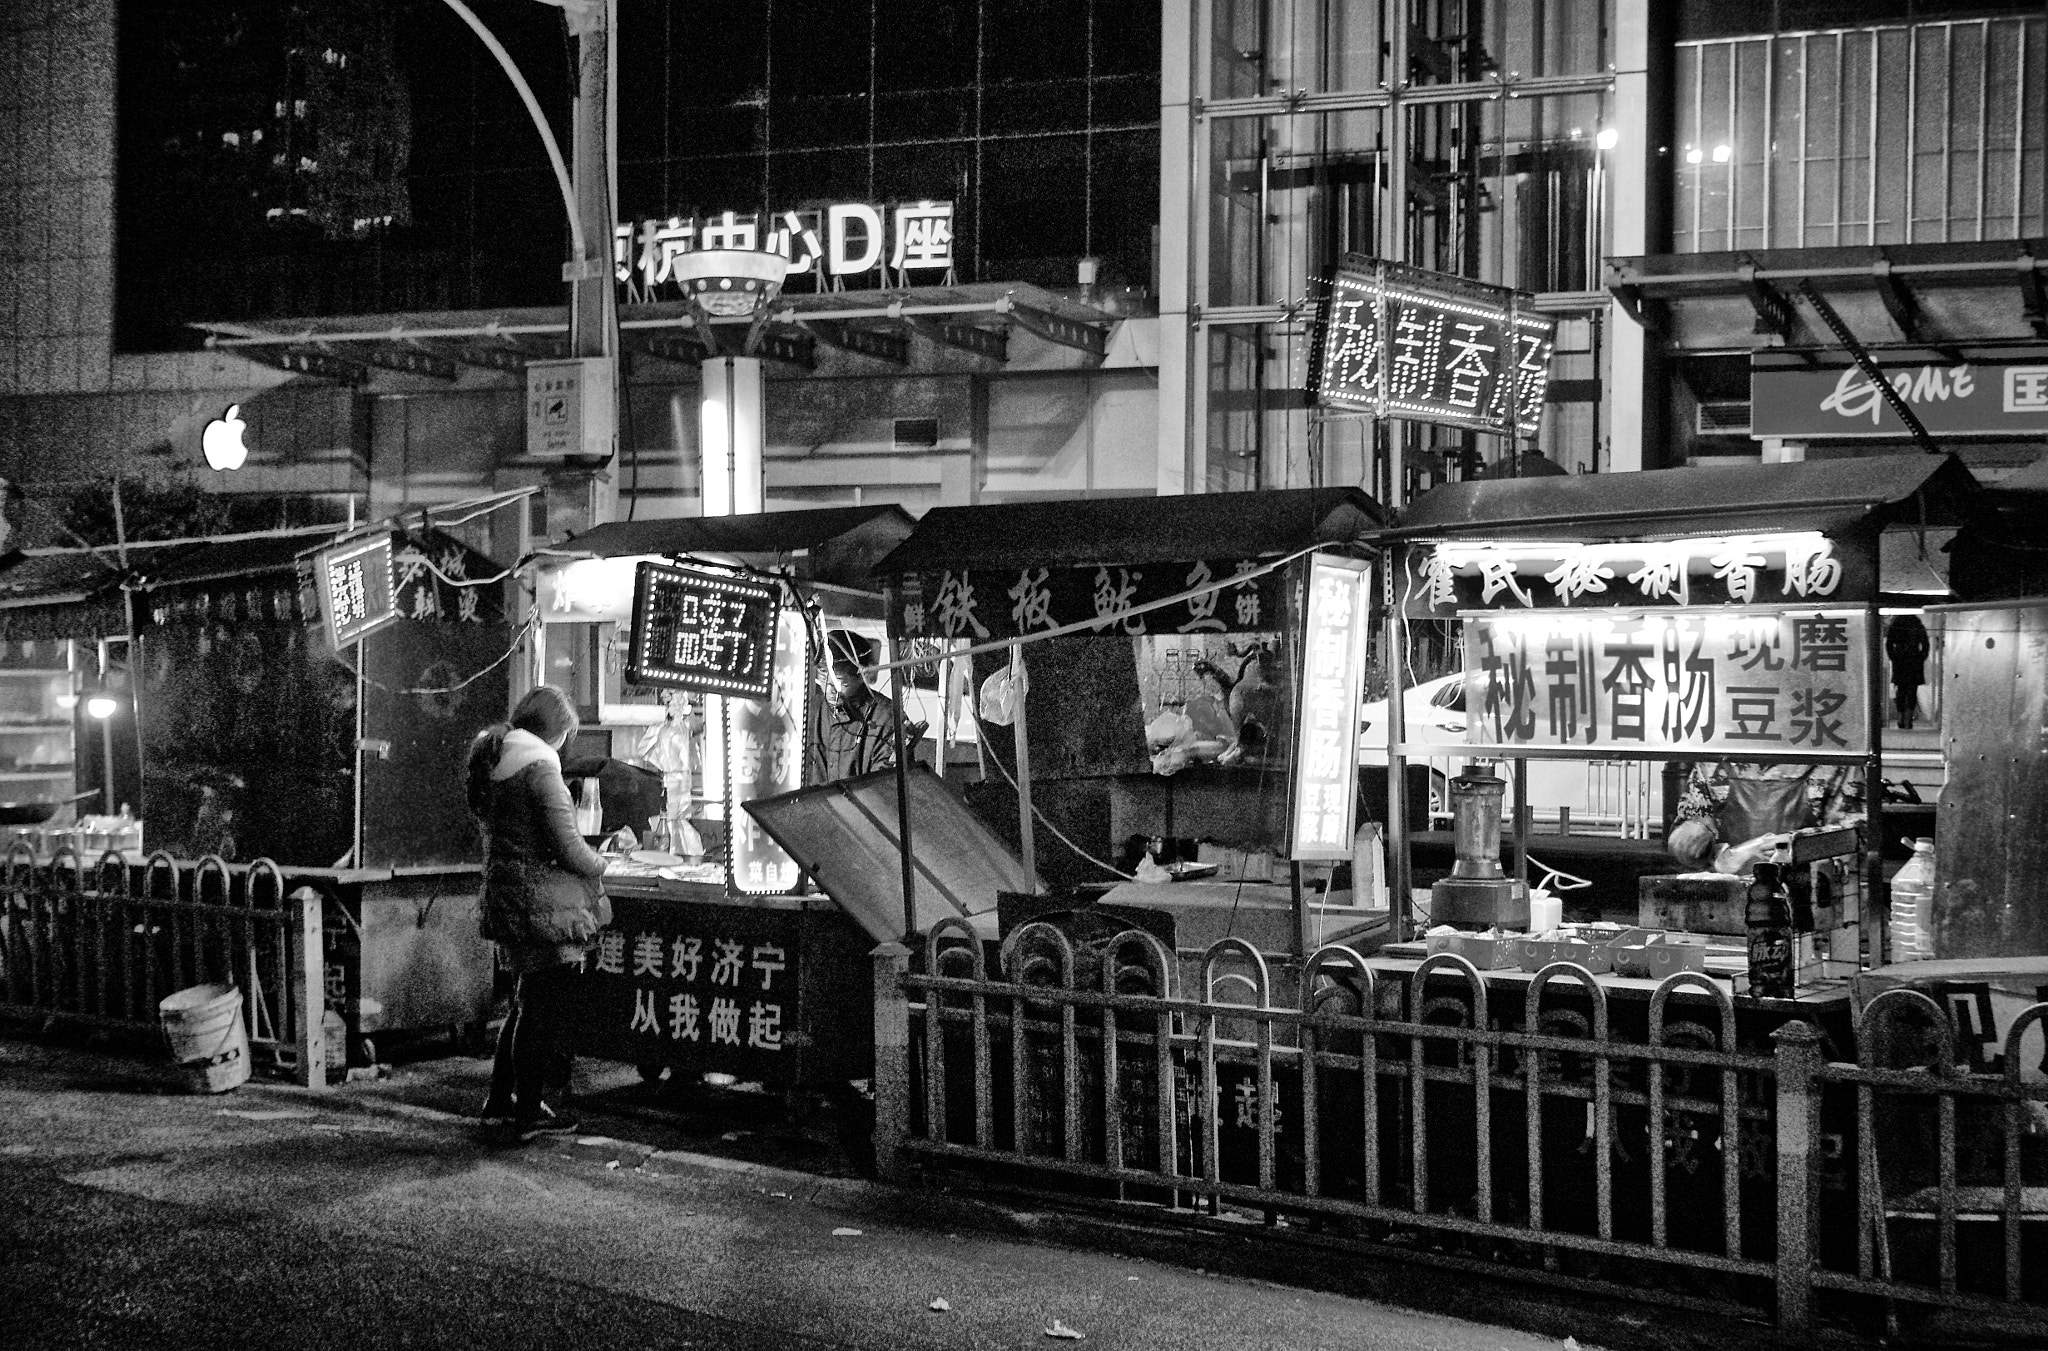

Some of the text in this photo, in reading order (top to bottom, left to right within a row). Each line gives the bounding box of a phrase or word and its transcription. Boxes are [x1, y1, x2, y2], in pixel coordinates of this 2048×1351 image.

[930, 559, 1228, 636] 铁板鱿鱼
[1725, 613, 1848, 672] 现磨
[1306, 578, 1351, 780] 秘制香肠
[1478, 617, 1716, 744] 秘制香肠
[1724, 686, 1848, 747] 豆浆
[572, 930, 786, 990] 建美好济宁
[631, 988, 782, 1050] 从我做起
